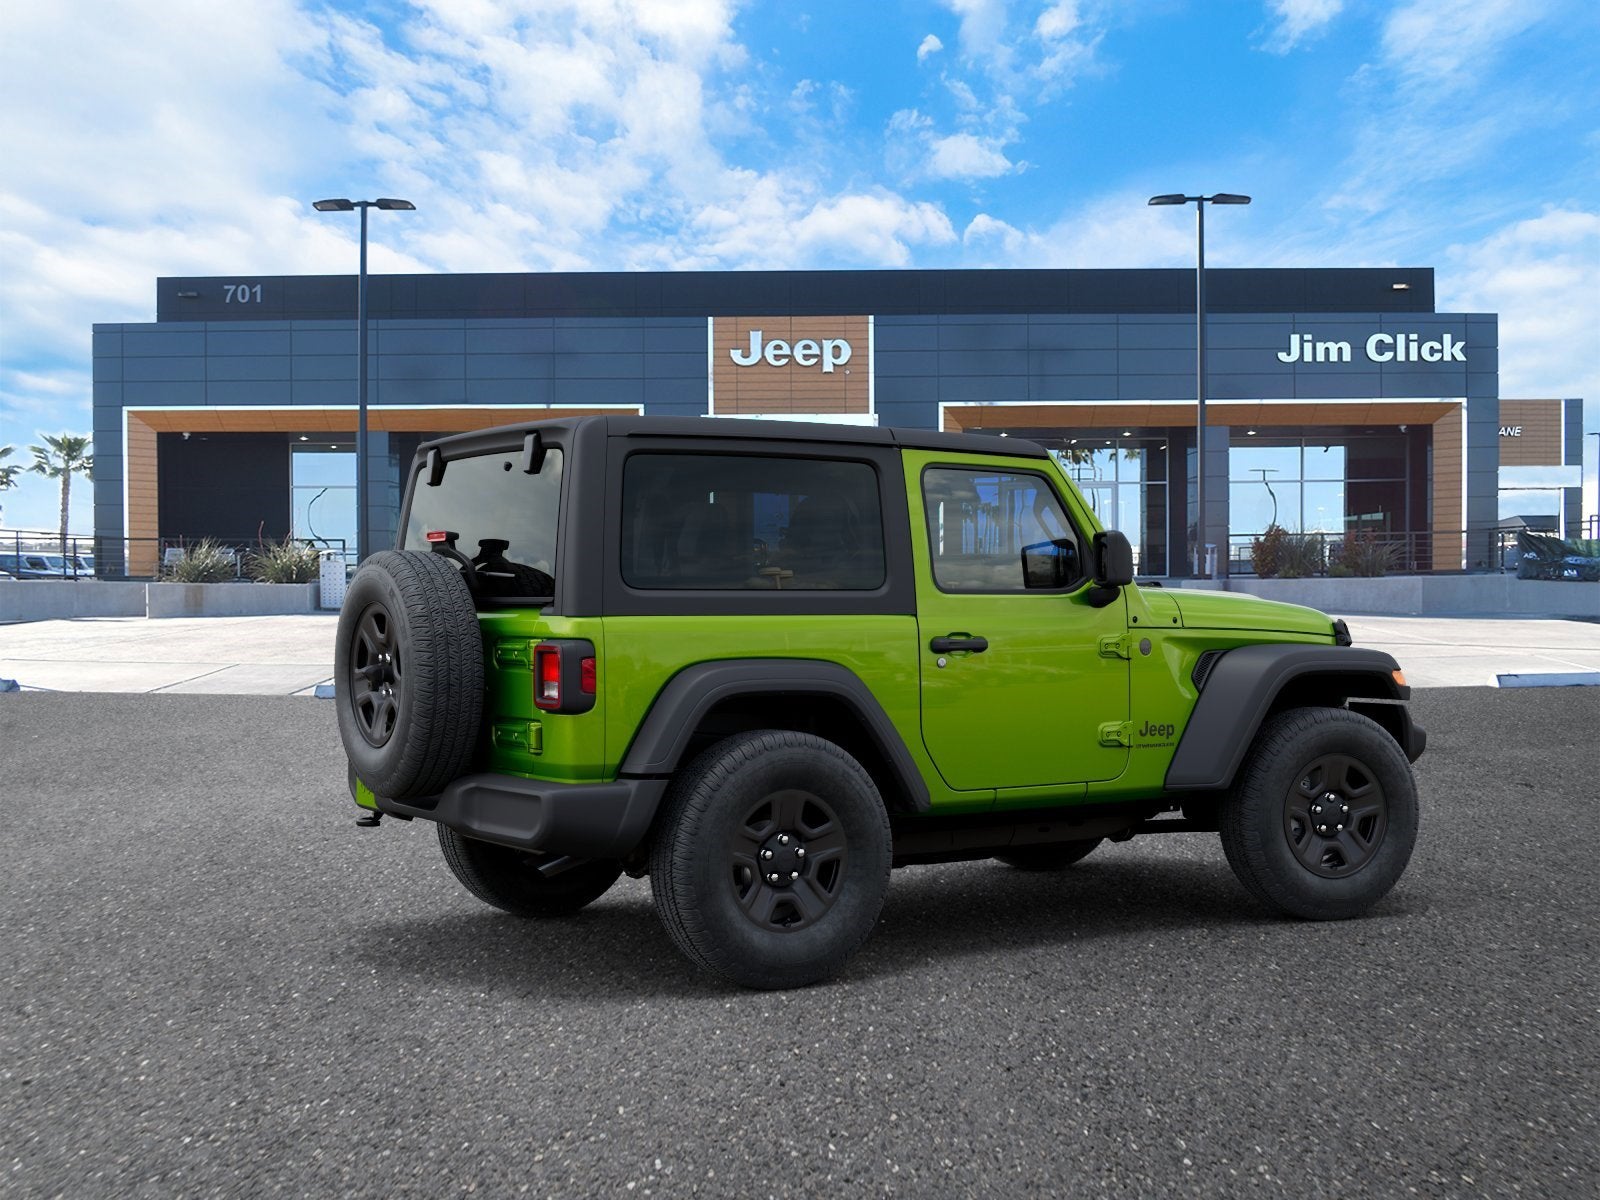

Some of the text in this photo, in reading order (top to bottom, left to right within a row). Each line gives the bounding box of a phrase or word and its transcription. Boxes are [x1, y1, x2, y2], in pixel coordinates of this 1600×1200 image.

[223, 284, 262, 304] 701
[729, 330, 852, 373] Jeep
[1277, 333, 1467, 363] Jim Click
[1138, 720, 1175, 740] Jeep
